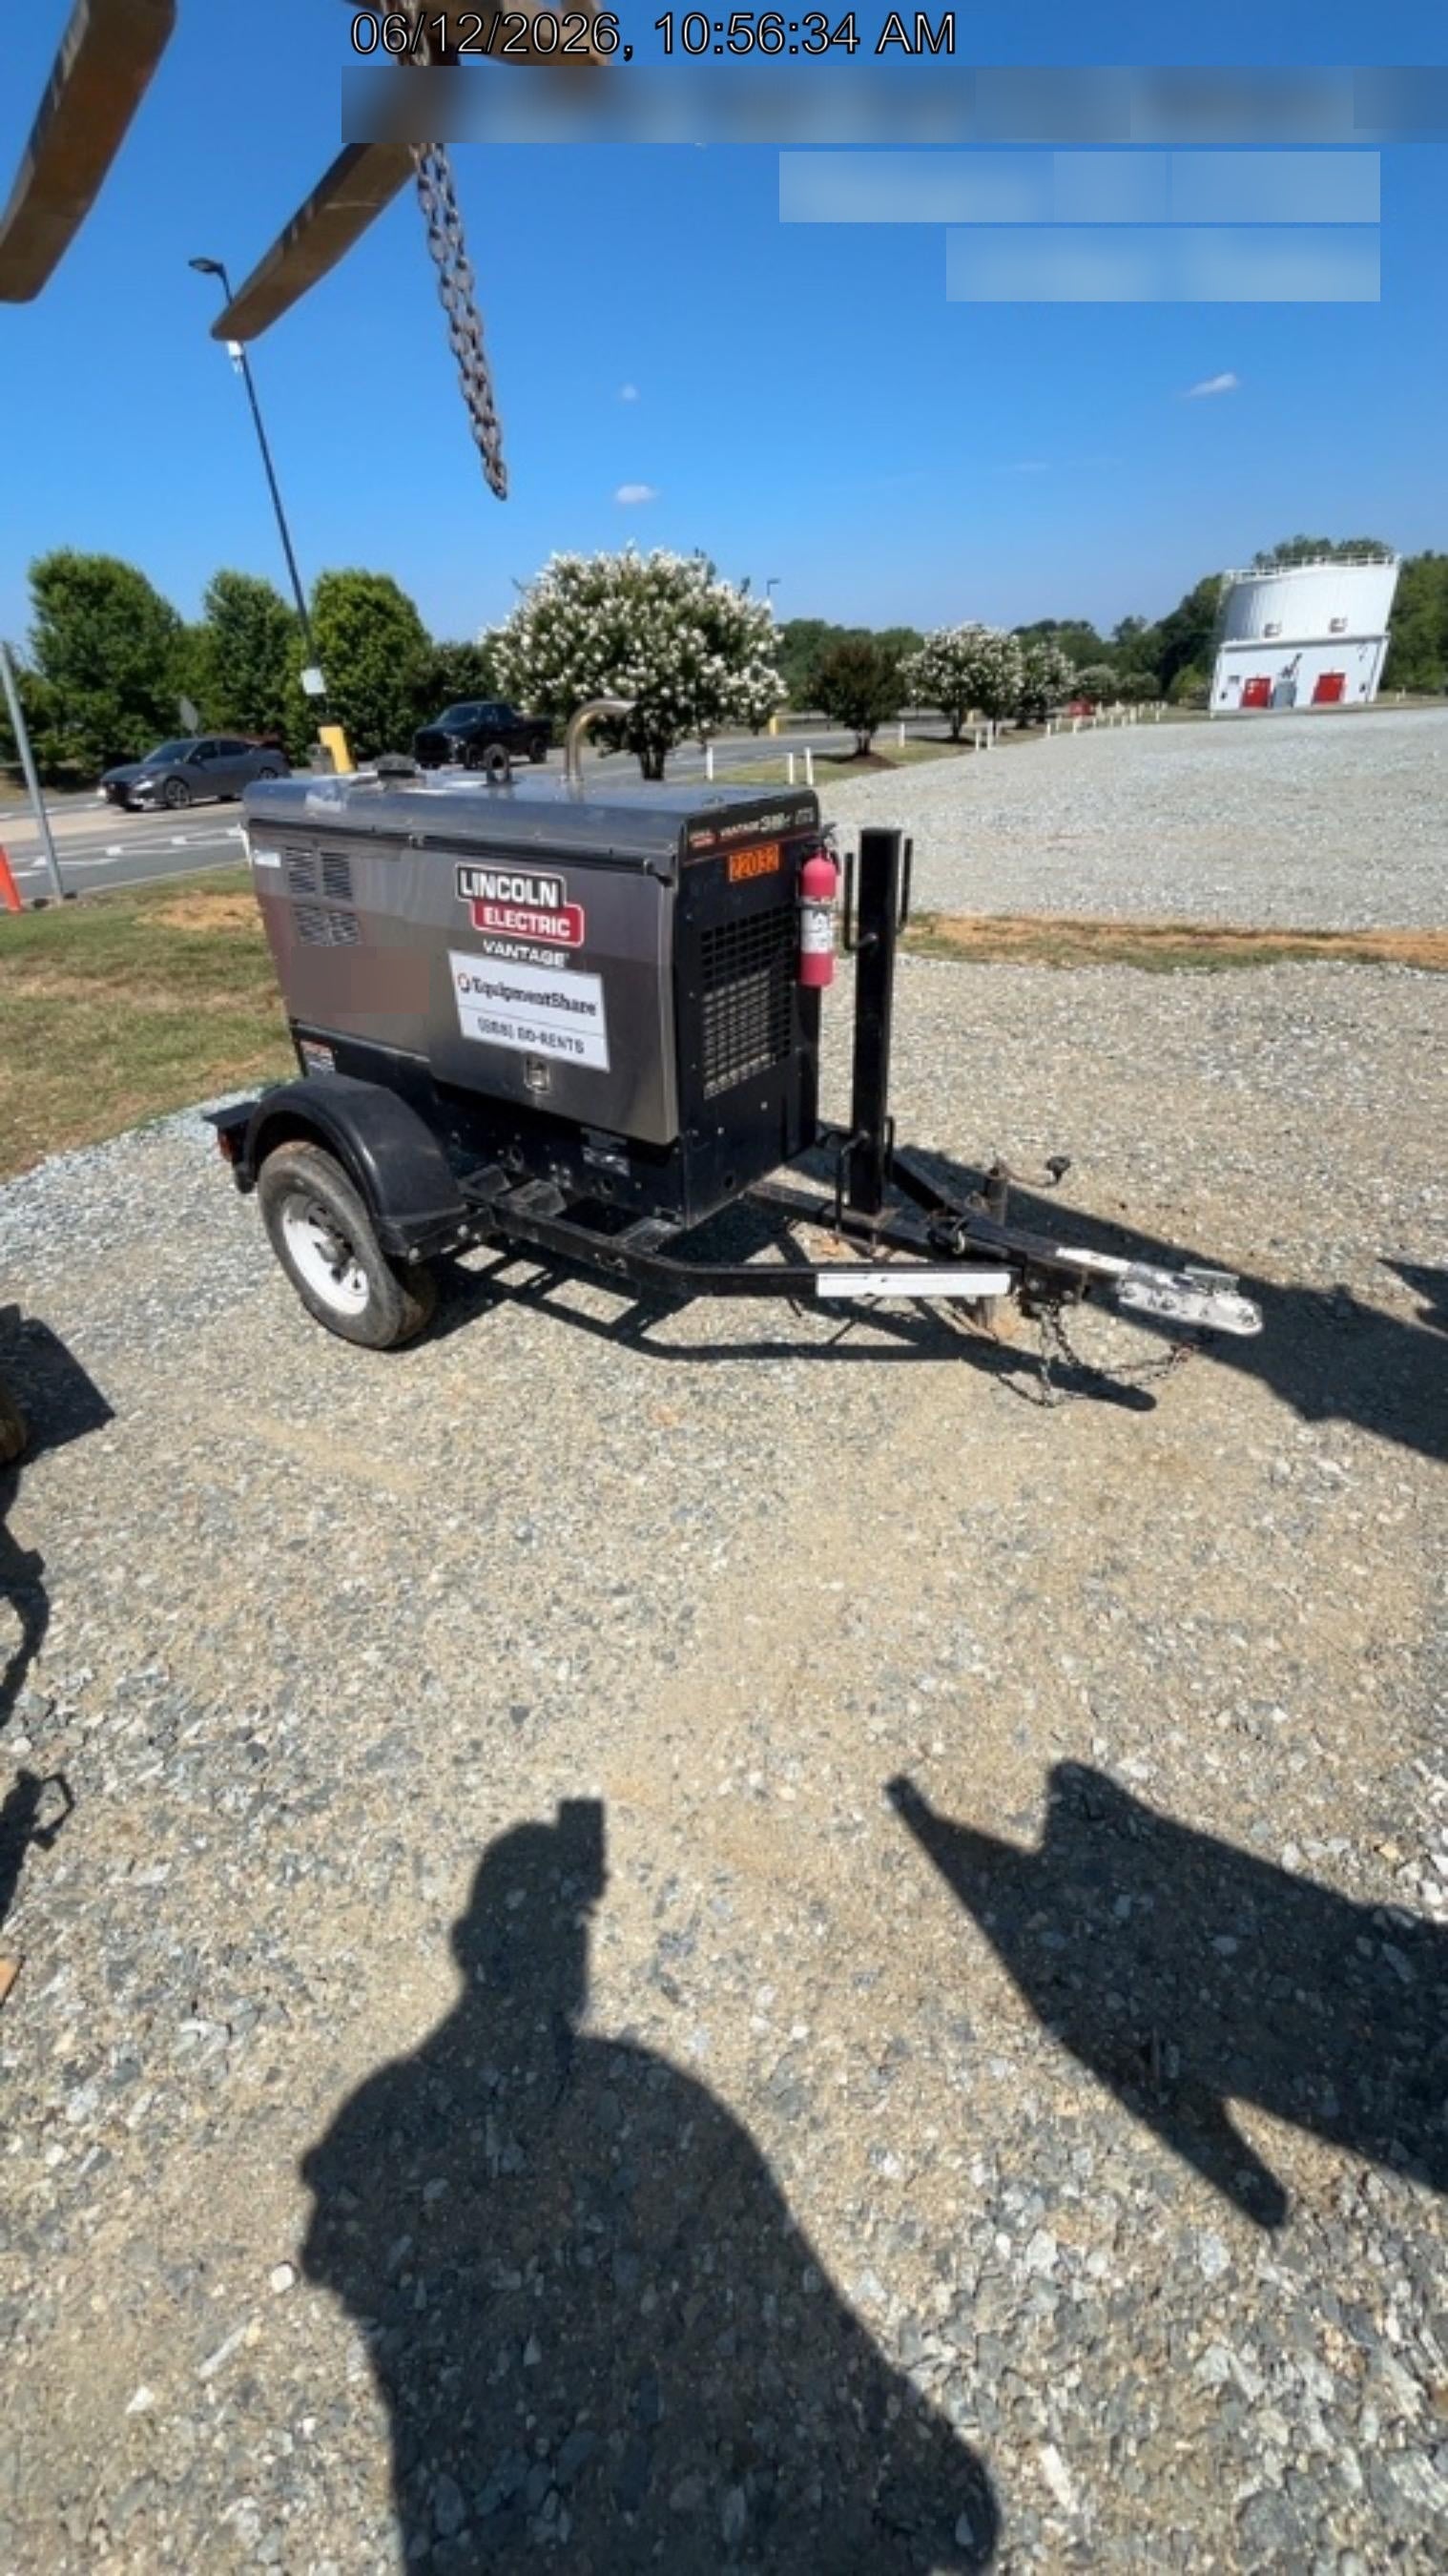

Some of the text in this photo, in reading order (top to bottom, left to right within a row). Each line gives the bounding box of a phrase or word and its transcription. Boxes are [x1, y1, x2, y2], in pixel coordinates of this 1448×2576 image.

[460, 869, 558, 908] LINCOLN
[483, 906, 570, 938] ELECTRIC
[483, 939, 566, 967] VANTAGE
[472, 976, 596, 1016] EquipmentShare
